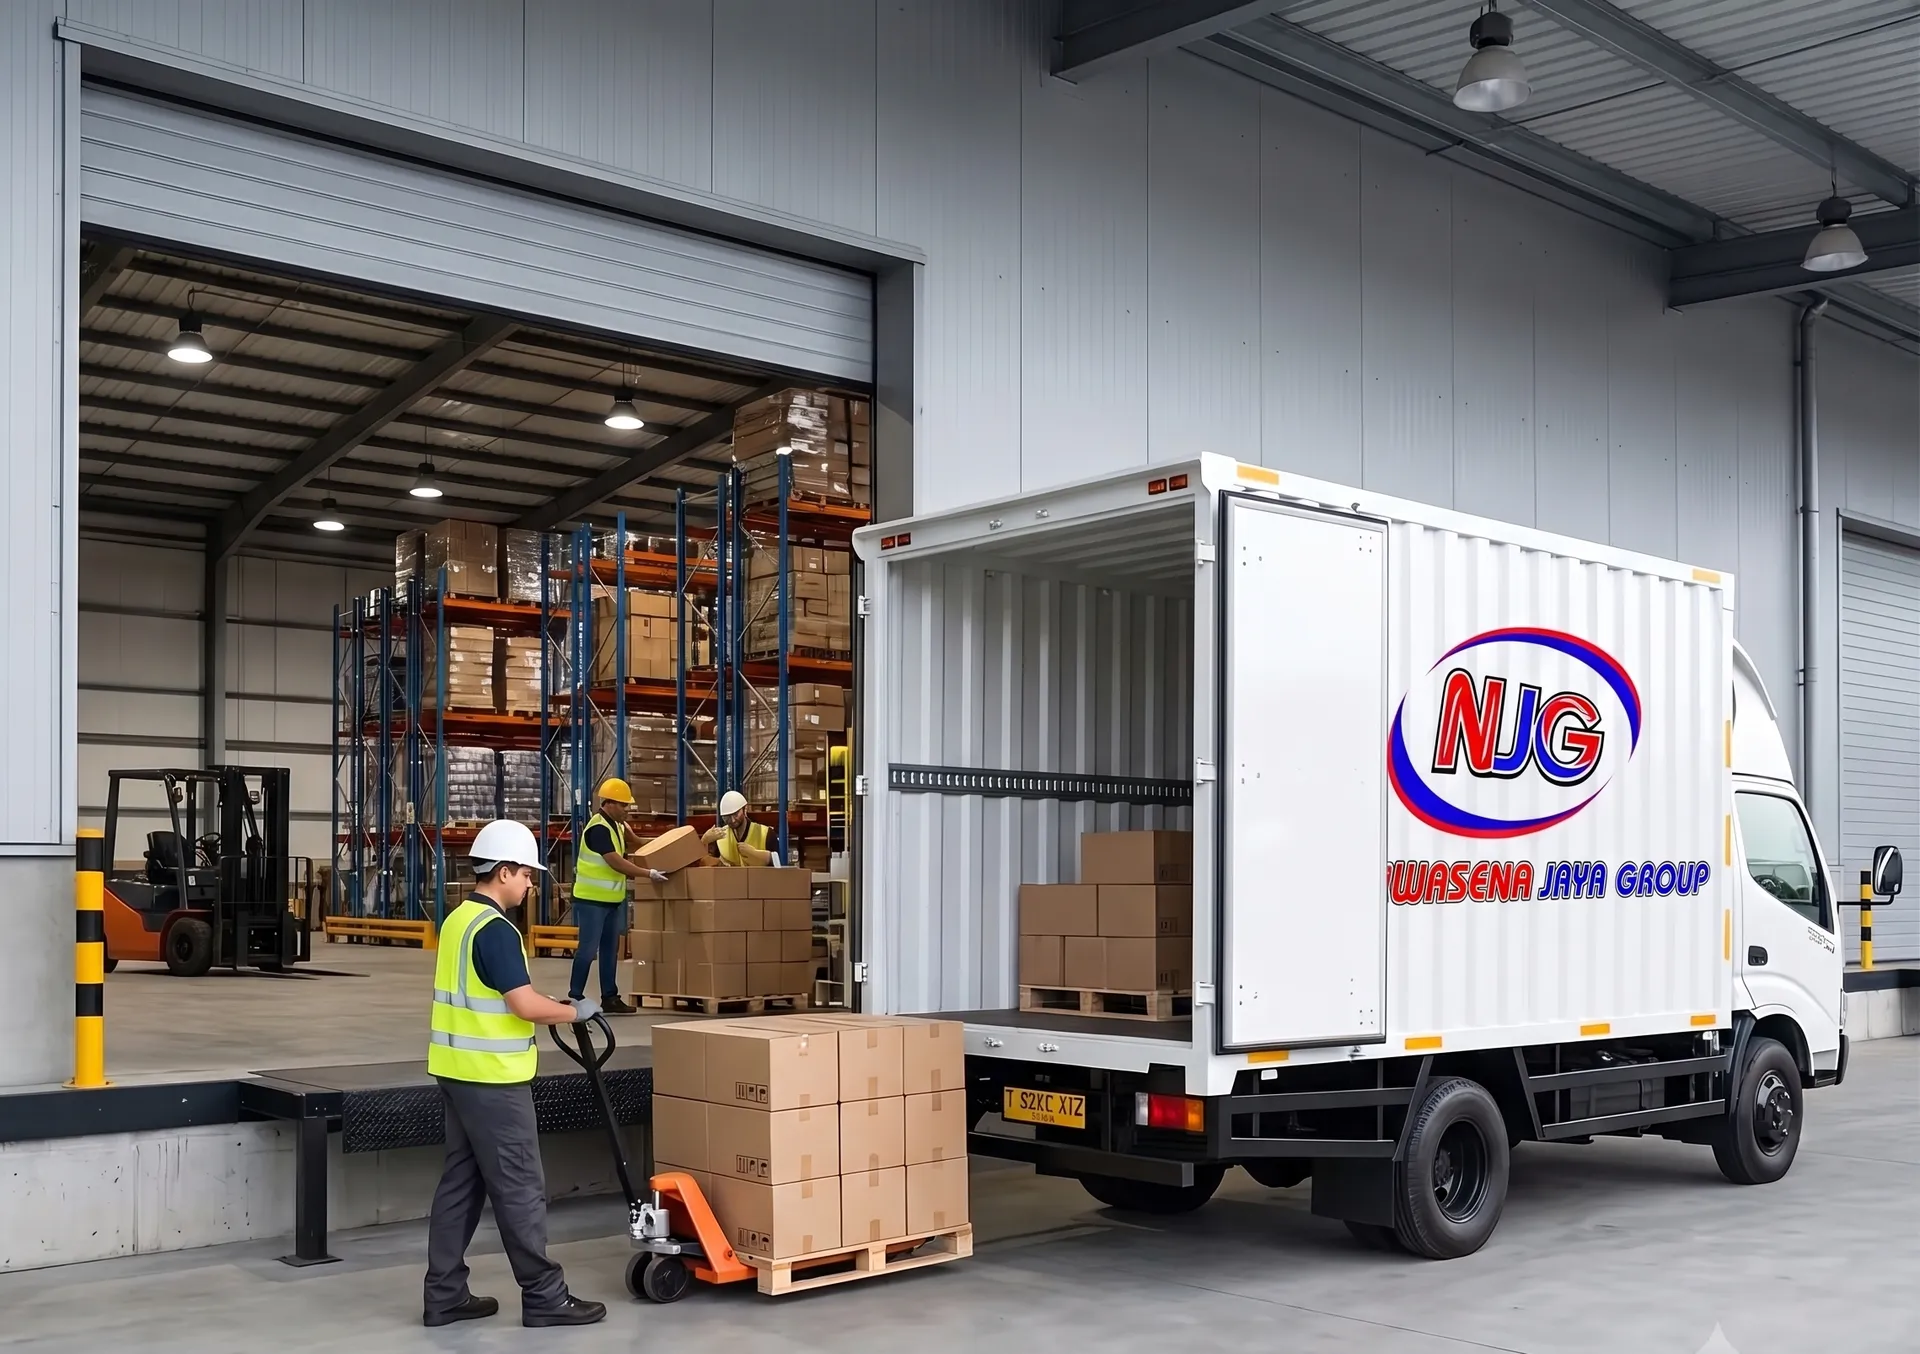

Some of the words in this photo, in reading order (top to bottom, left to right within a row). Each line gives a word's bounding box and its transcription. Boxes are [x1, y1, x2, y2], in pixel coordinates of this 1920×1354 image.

[1431, 667, 1605, 787] NJG
[1537, 860, 1608, 900] JAYA
[1615, 860, 1711, 898] GROUP
[1005, 1089, 1014, 1108] T
